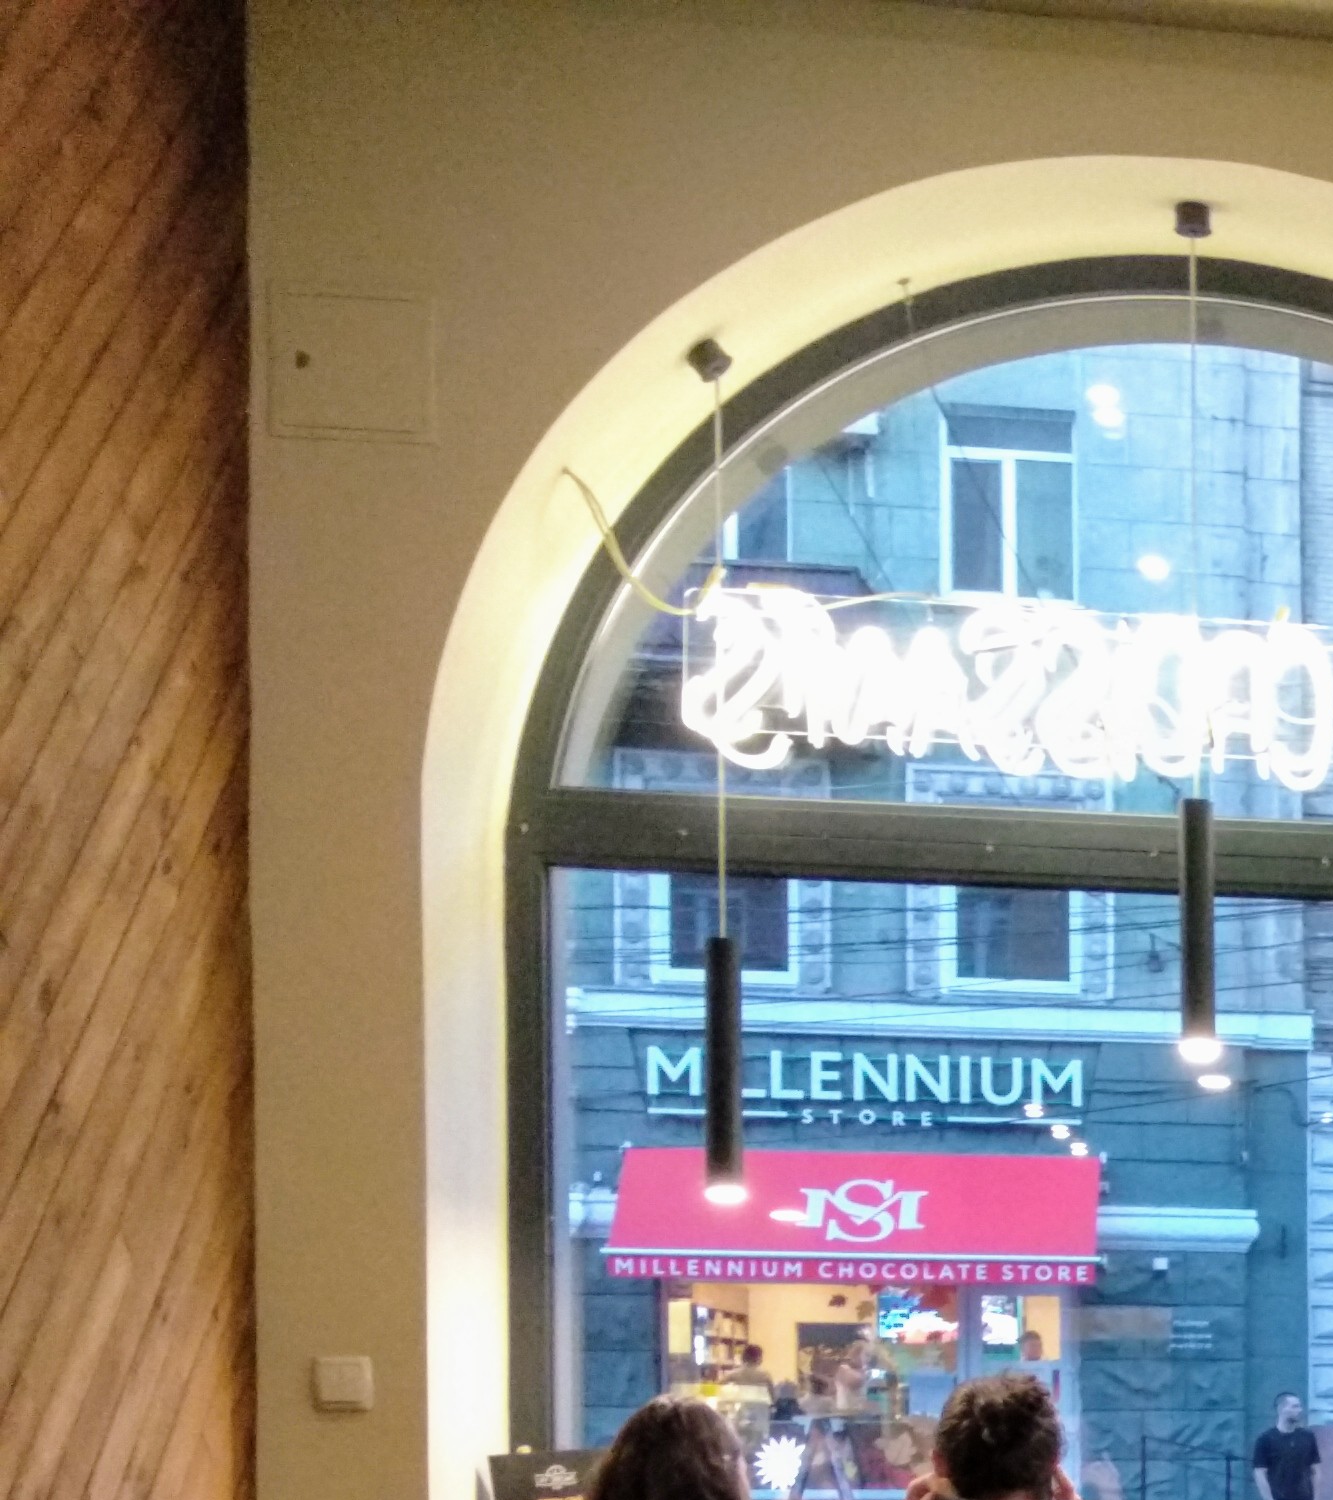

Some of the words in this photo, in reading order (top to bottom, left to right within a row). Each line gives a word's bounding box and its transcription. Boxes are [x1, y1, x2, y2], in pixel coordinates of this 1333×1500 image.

[646, 1045, 1083, 1108] MLENNIUM
[800, 1108, 934, 1128] STORE
[613, 1257, 804, 1279] MILLENNIUM
[817, 1260, 989, 1282] CHOCOLATE
[1001, 1263, 1090, 1283] STORE
